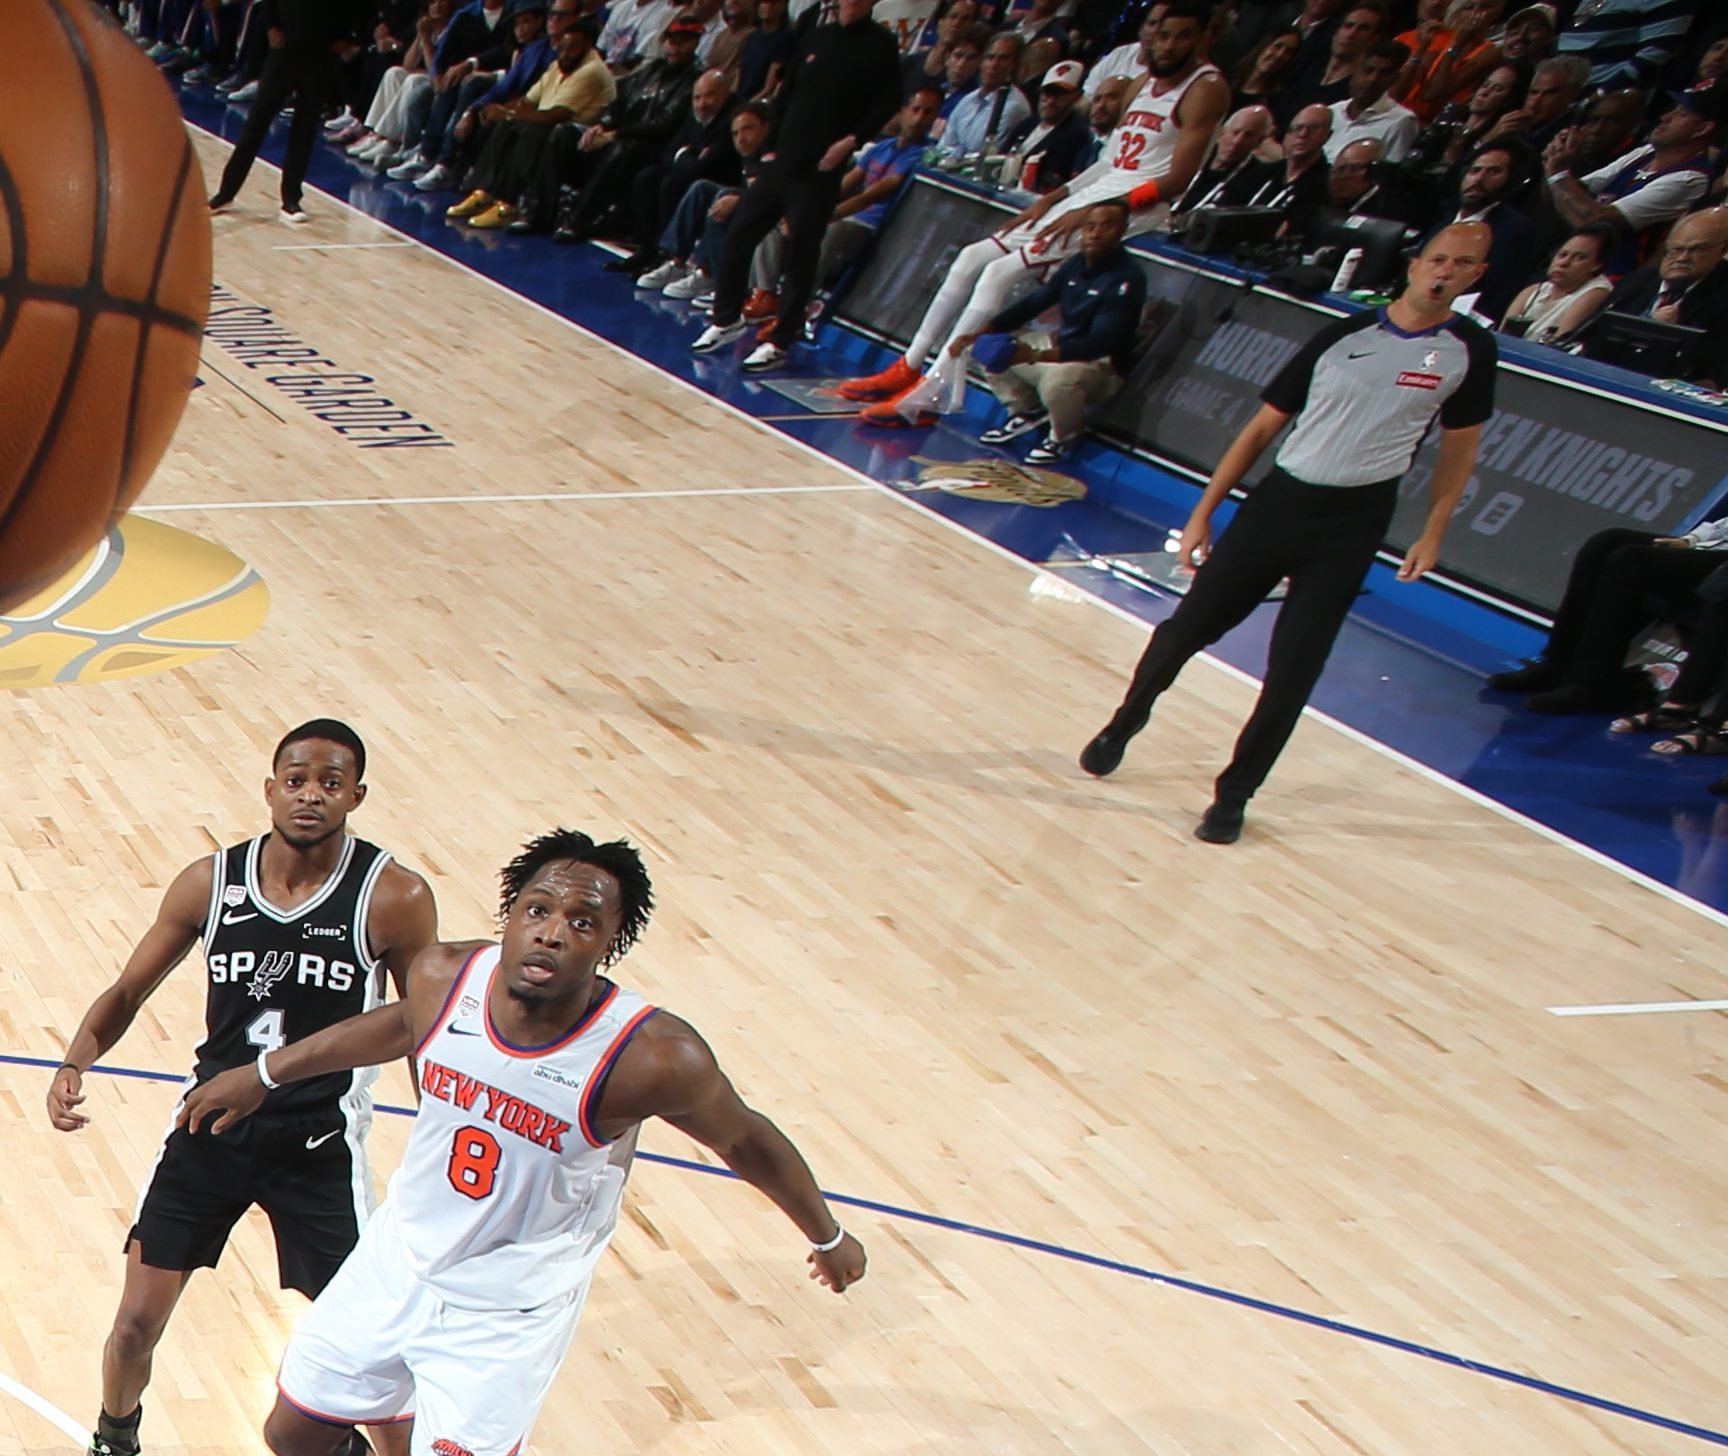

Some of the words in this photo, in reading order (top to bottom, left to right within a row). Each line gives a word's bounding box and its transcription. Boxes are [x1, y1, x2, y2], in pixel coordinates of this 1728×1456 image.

[1113, 131, 1147, 170] 32
[265, 373, 455, 448] GARDEN
[1512, 428, 1694, 522] KNIGHTS
[307, 928, 342, 938] LEDGER
[245, 1008, 287, 1052] 4
[421, 1059, 484, 1113] NEW
[482, 1085, 573, 1155] YORK
[447, 1125, 502, 1201] 8
